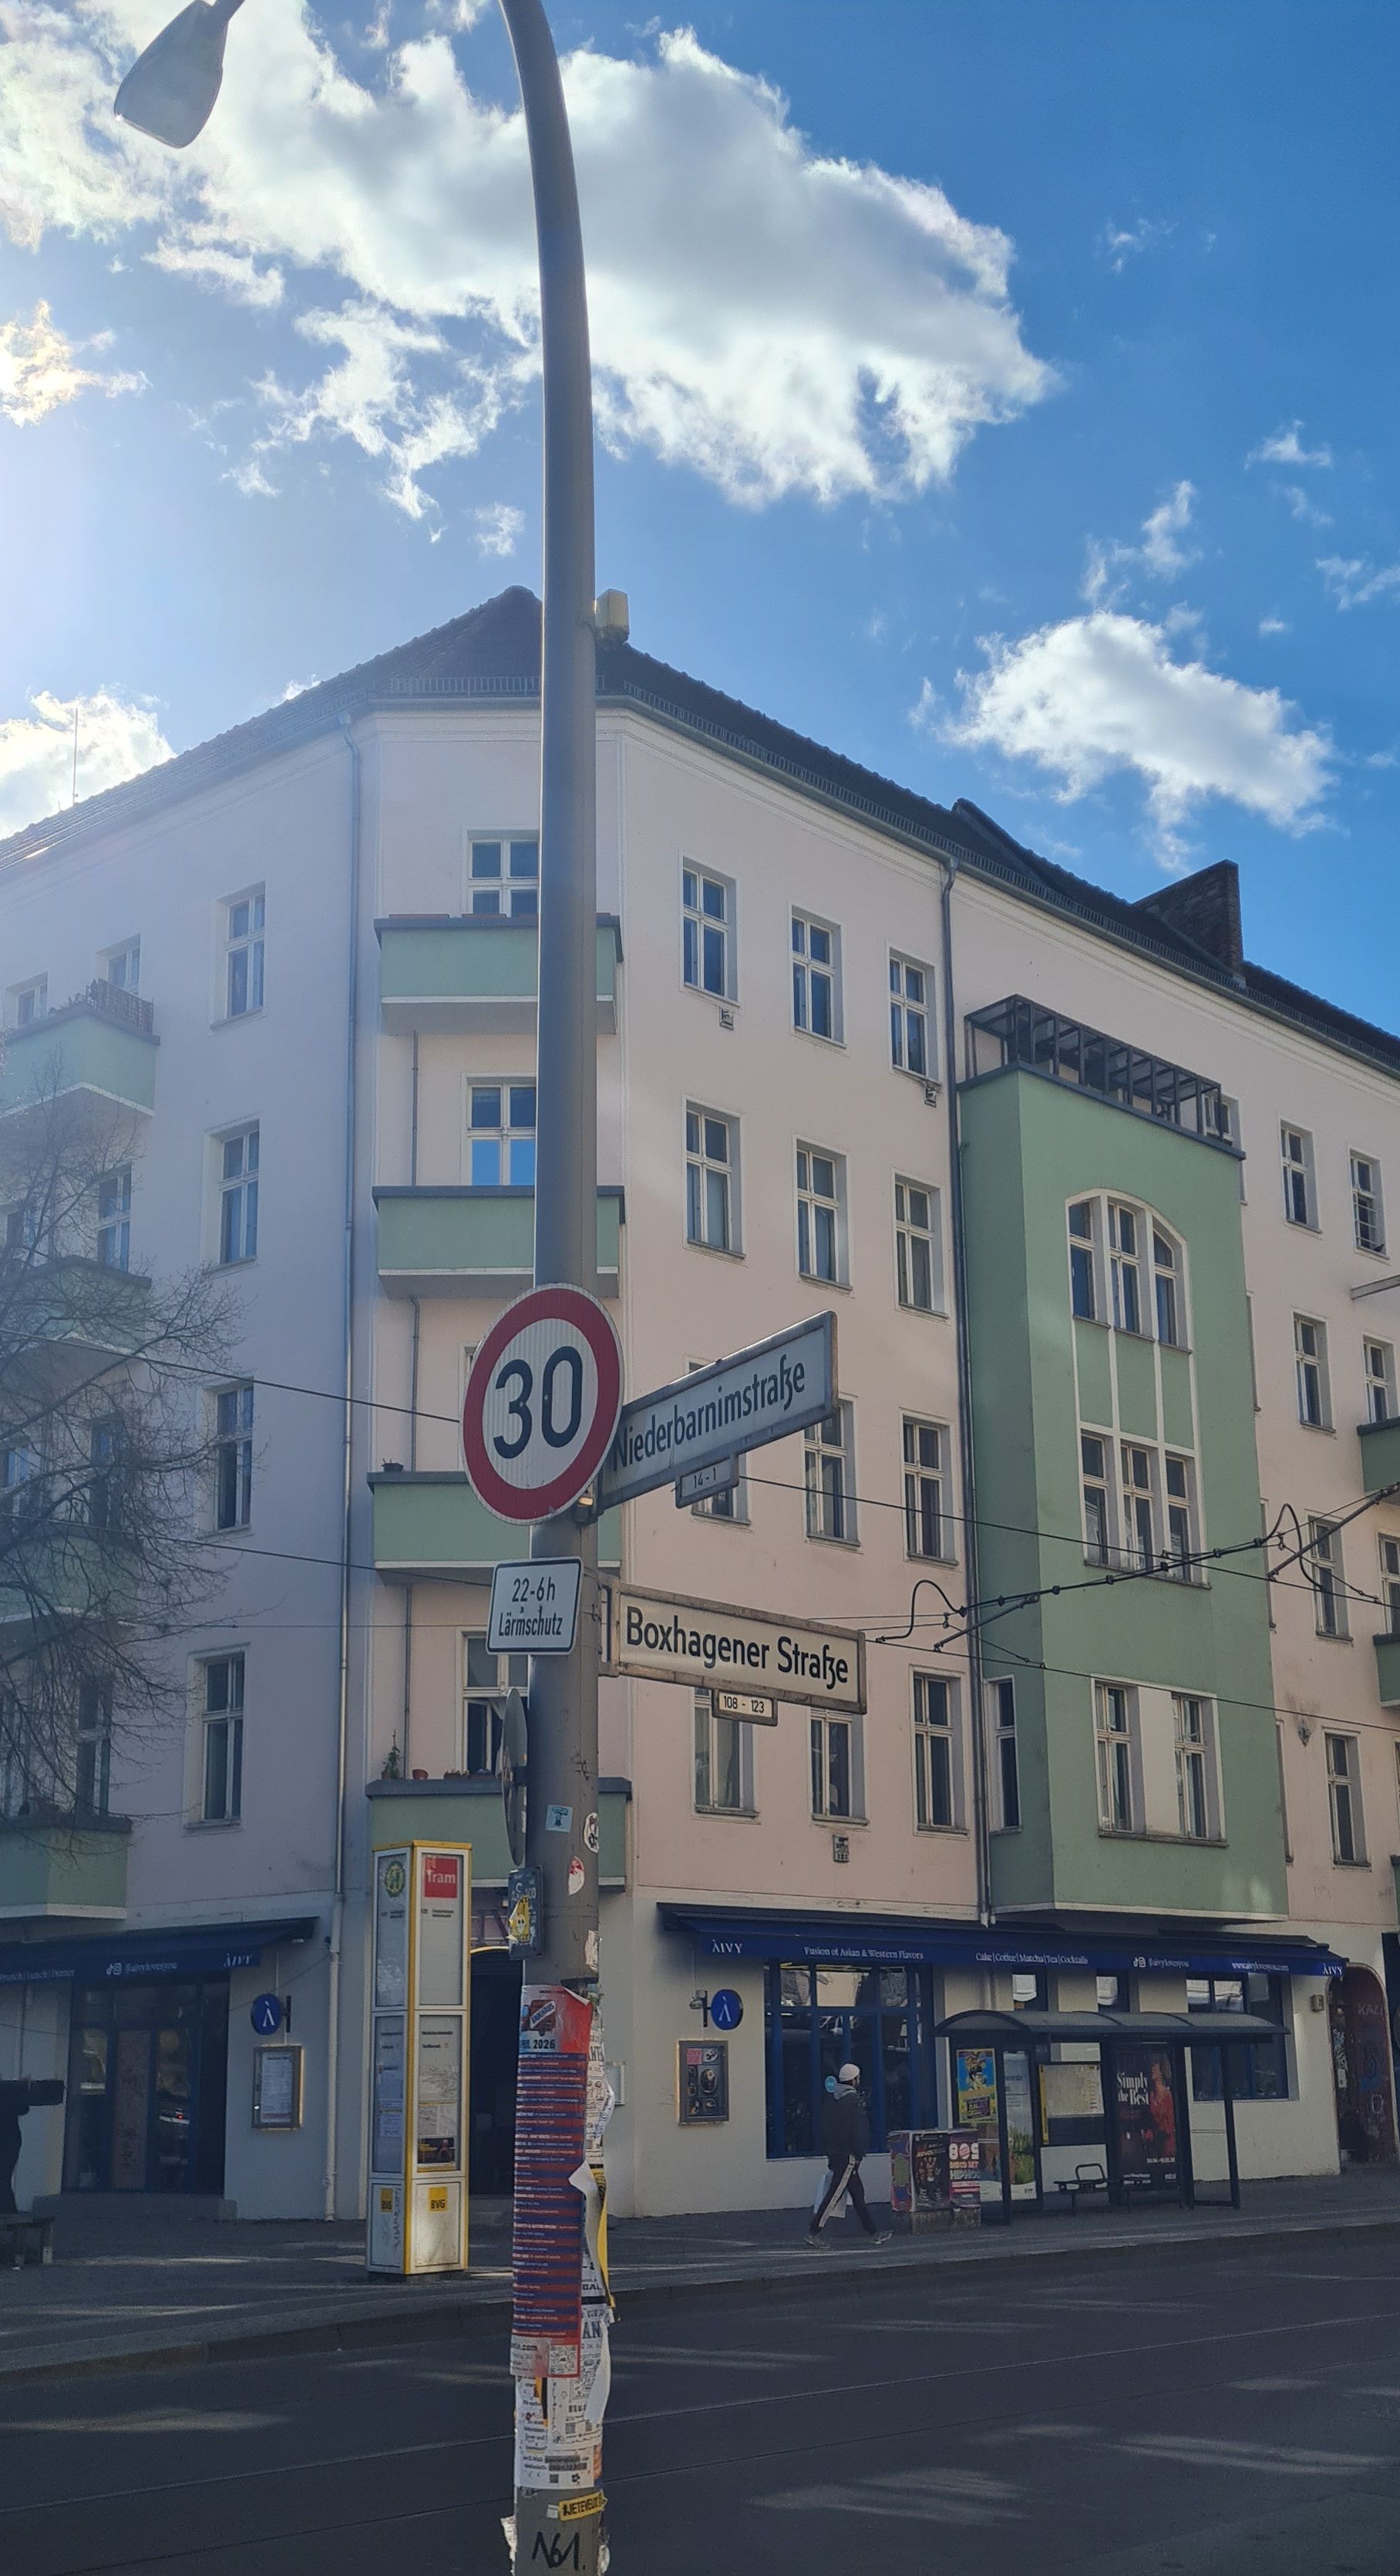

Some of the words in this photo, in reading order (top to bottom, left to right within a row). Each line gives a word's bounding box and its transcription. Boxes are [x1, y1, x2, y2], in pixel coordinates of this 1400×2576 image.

[493, 1346, 583, 1459] 30
[613, 1354, 805, 1471] Niederbarnimstraße
[498, 1611, 563, 1637] Lärmschutz
[627, 1606, 770, 1670] Boxhagener
[777, 1635, 849, 1690] Straße
[723, 1695, 738, 1710] 108
[751, 1699, 766, 1714] 123
[426, 1869, 456, 1884] Tram
[804, 1946, 830, 1956] Fusion
[831, 1947, 840, 1957] of
[840, 1948, 860, 1958] Asian
[861, 1949, 867, 1958] &
[867, 1949, 898, 1959] Western
[898, 1949, 924, 1960] Flavors
[533, 2039, 556, 2050] 2026
[1116, 2072, 1149, 2093] Simply
[1117, 2088, 1129, 2102] the
[1129, 2089, 1149, 2106] Best
[430, 2199, 446, 2209] BVG
